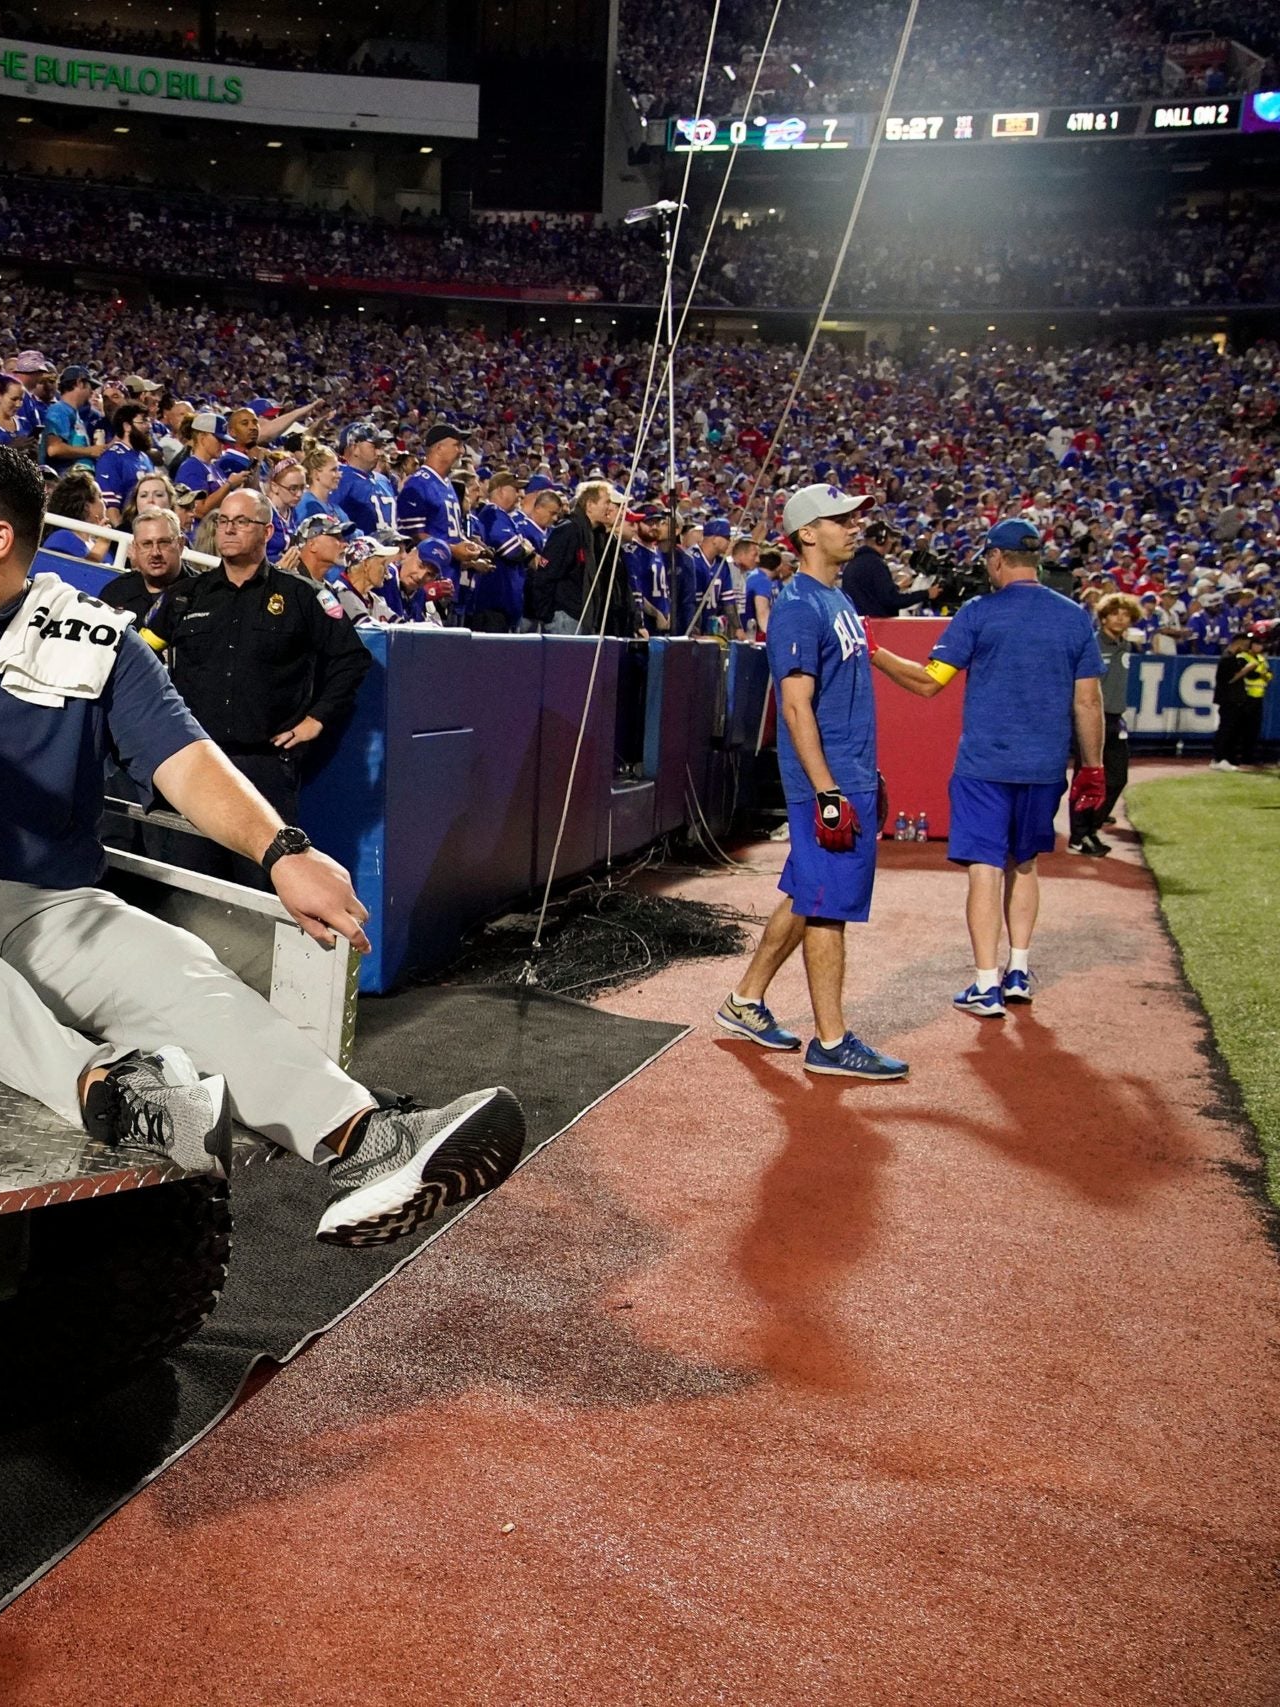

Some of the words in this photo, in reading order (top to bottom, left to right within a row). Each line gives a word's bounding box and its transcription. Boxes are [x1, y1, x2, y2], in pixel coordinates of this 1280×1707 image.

[34, 54, 162, 96] BUFFALO
[164, 69, 244, 104] BILLS
[885, 116, 943, 140] 5:27
[1066, 112, 1095, 131] 4TH
[1110, 111, 1118, 129] 1
[1154, 107, 1192, 128] BALL
[1194, 105, 1217, 124] ON
[1217, 104, 1229, 123] 2
[730, 121, 746, 144] 0
[823, 119, 838, 142] 7
[370, 495, 398, 532] 17
[28, 606, 124, 653] GATO
[1122, 662, 1221, 733] LS
